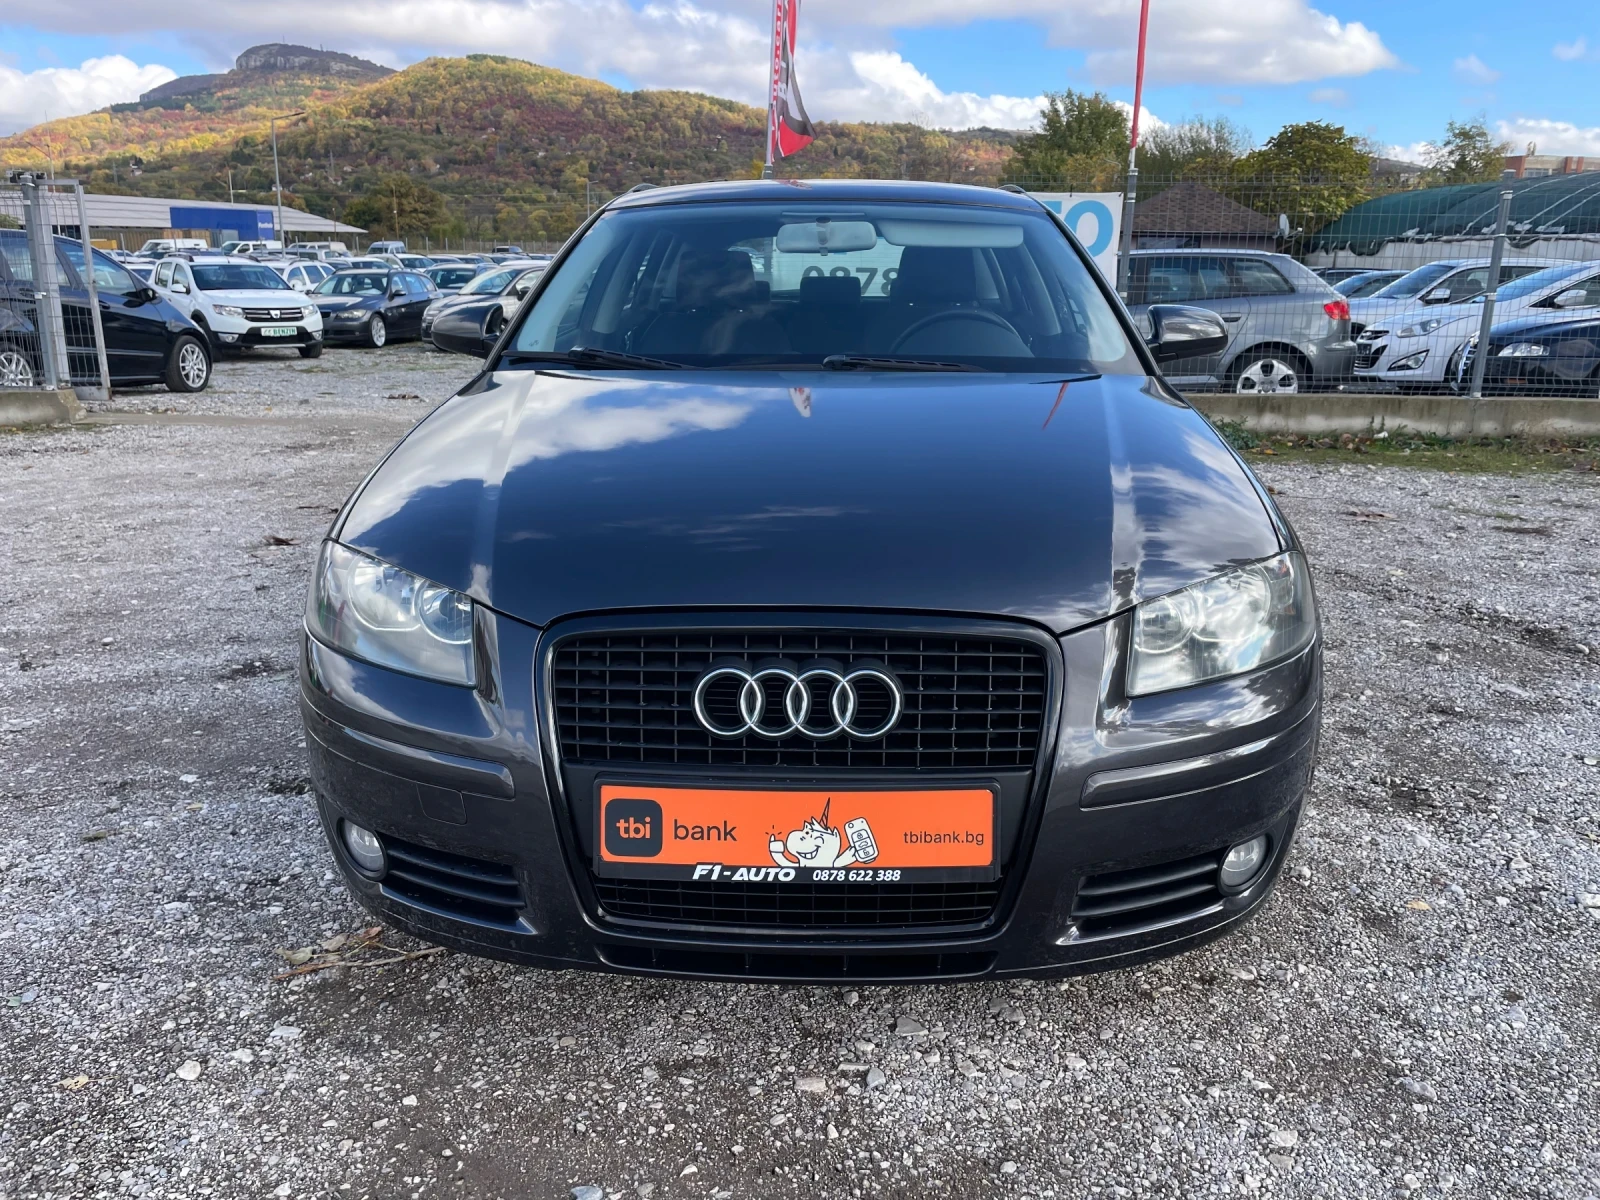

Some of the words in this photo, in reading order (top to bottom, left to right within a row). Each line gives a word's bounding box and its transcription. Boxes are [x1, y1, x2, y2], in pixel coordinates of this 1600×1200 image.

[273, 328, 296, 336] BENZIN
[616, 816, 651, 839] tbi
[673, 819, 737, 842] bank
[903, 830, 985, 846] tbibank.bg
[692, 864, 796, 882] F1-AUTO
[812, 869, 846, 881] 0878
[848, 869, 874, 881] 622
[875, 869, 902, 881] 388
